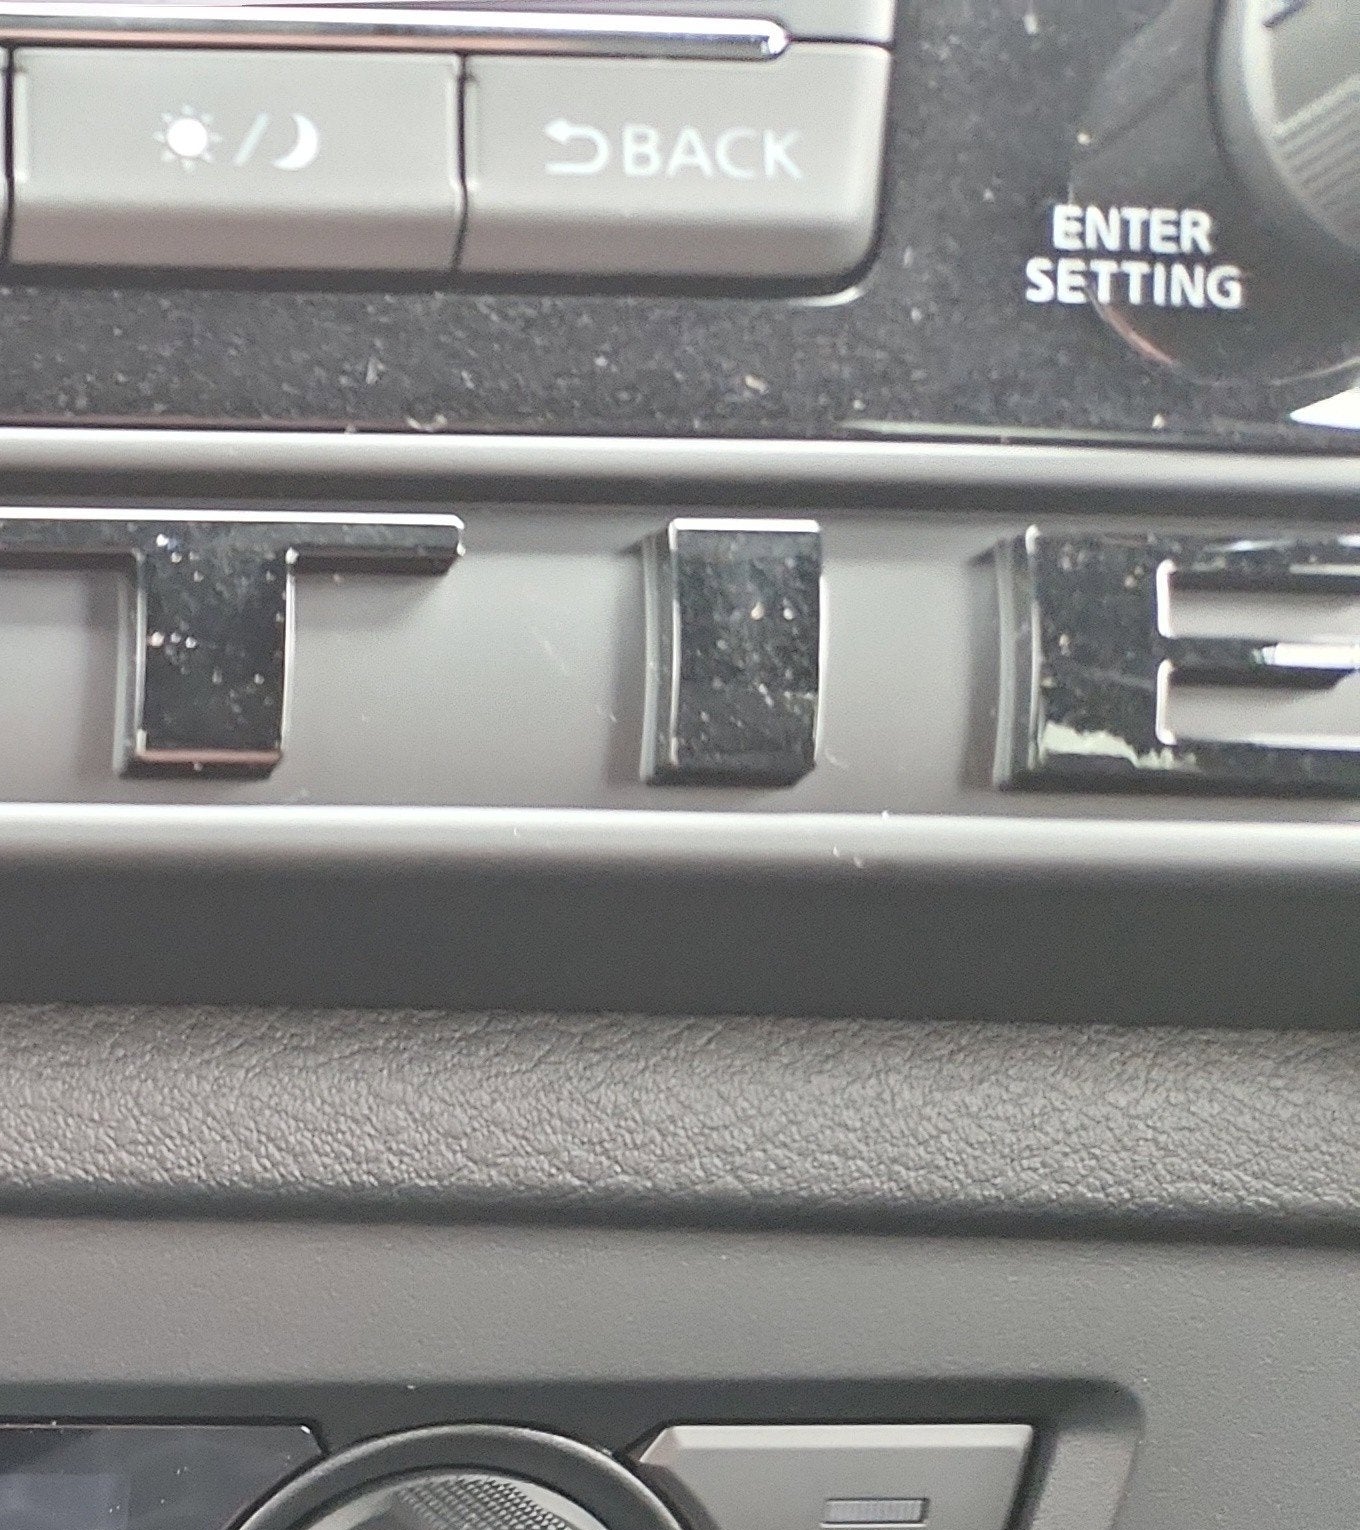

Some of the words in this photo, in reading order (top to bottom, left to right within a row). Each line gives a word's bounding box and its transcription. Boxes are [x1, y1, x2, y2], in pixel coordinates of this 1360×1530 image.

[623, 124, 804, 181] BACK
[1051, 202, 1213, 255] ENTER
[1024, 256, 1243, 310] SETTING
